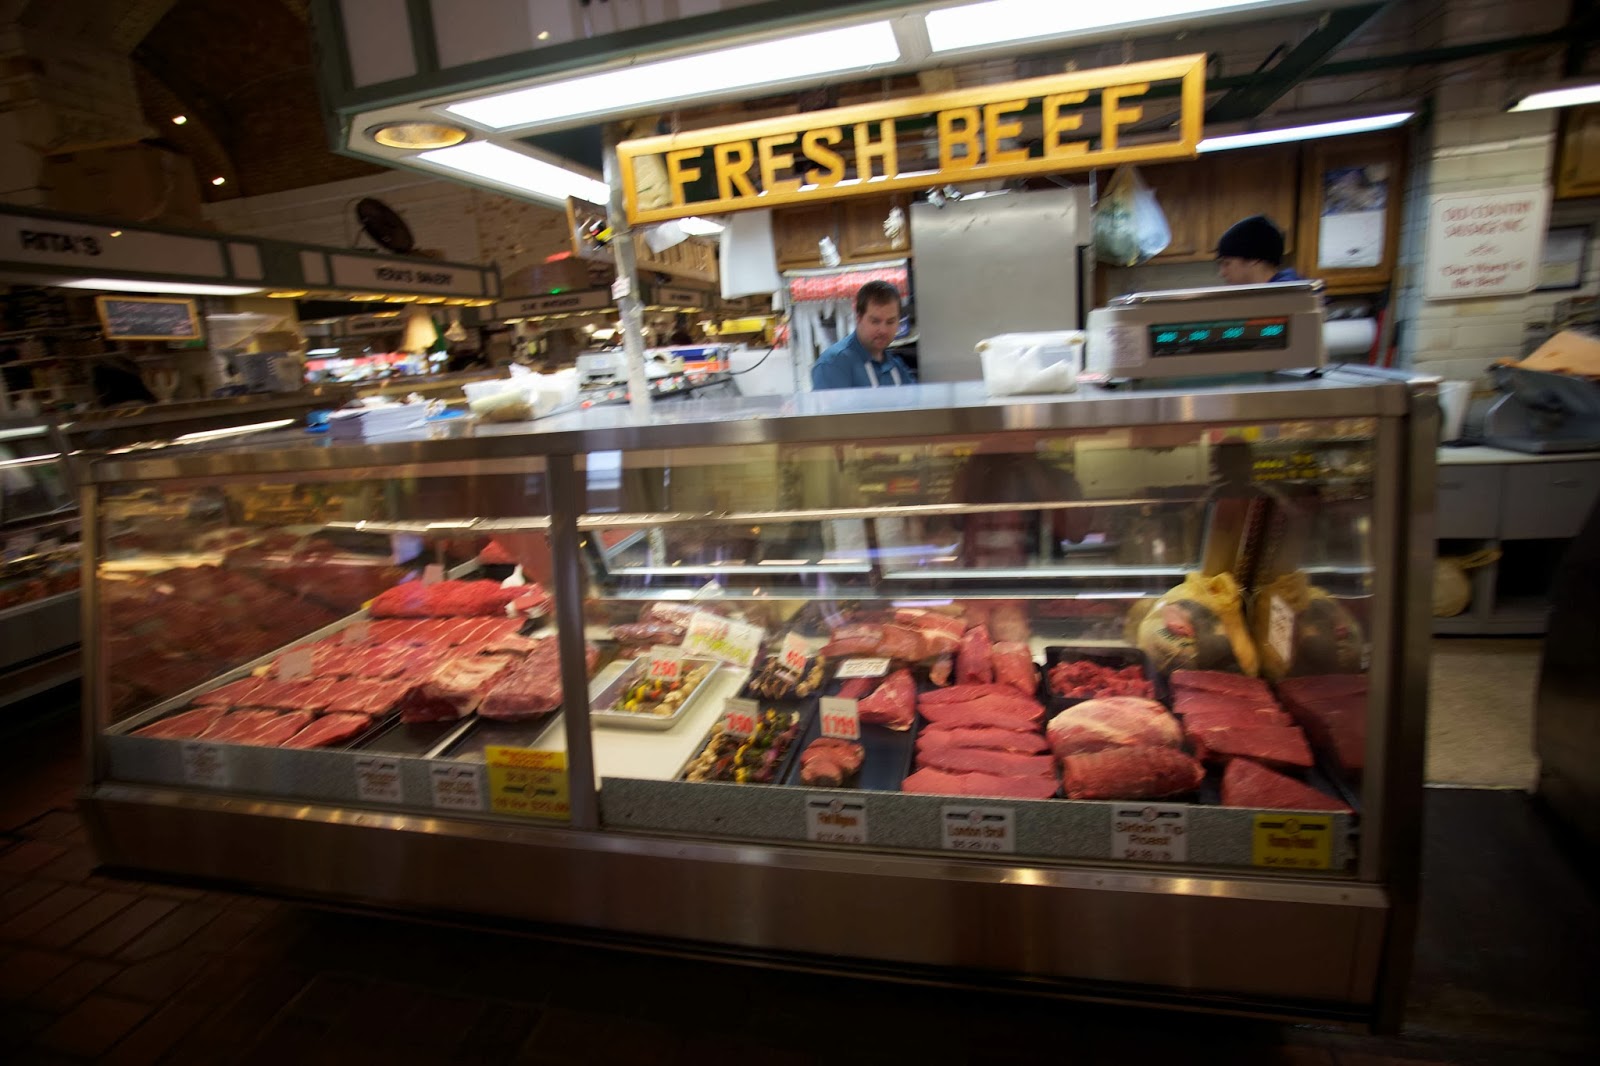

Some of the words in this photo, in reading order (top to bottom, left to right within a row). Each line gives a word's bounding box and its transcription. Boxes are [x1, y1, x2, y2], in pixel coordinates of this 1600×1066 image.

[666, 118, 897, 206] FRESH
[938, 81, 1151, 171] BEEF
[19, 229, 103, 257] RITA'S
[947, 824, 981, 837] London
[1128, 834, 1172, 846] Roast
